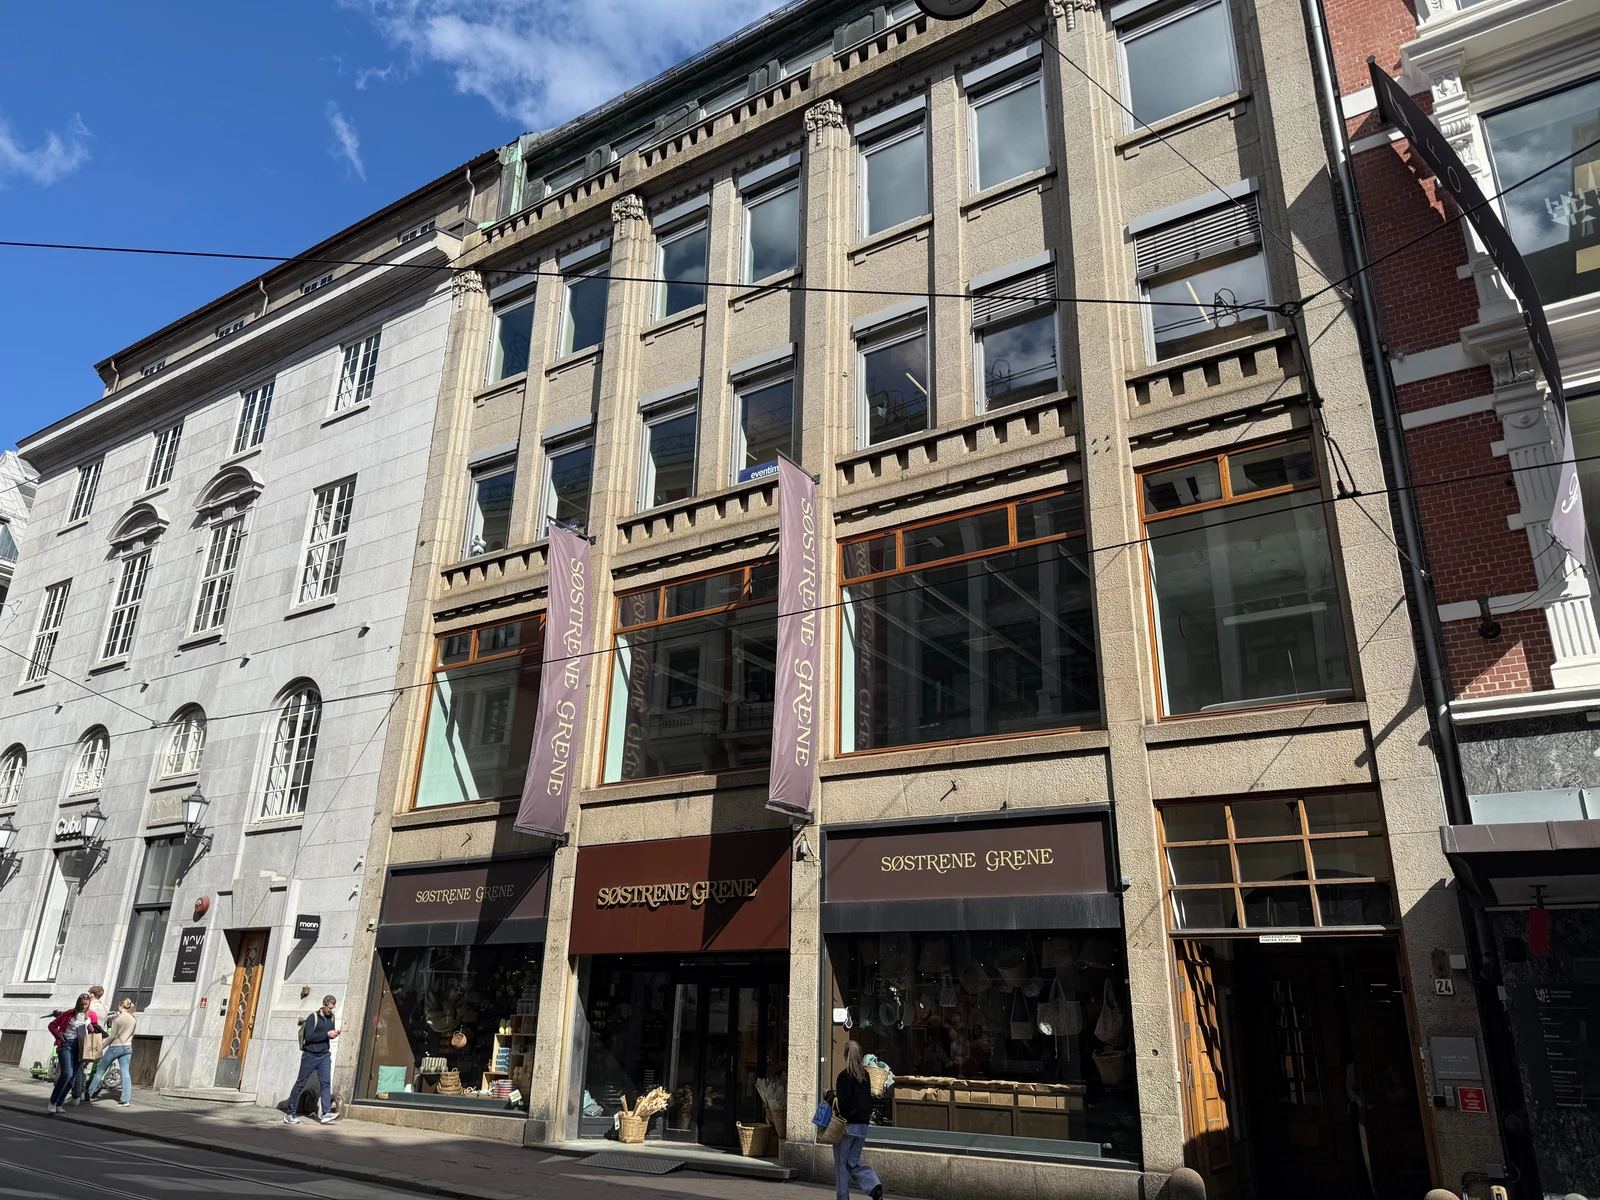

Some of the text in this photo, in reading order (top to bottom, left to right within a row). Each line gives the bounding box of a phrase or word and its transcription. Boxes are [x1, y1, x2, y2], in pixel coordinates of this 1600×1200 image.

[562, 558, 585, 690] SØSTRENE
[794, 497, 816, 767] SØSTRENE GRENE
[546, 700, 576, 797] GRENE
[881, 848, 1054, 874] SØSTRENE GRENE
[415, 884, 514, 905] SØSTRENE GRENE
[598, 879, 758, 908] SØSTRENE GRENE
[1437, 980, 1451, 993] 24
